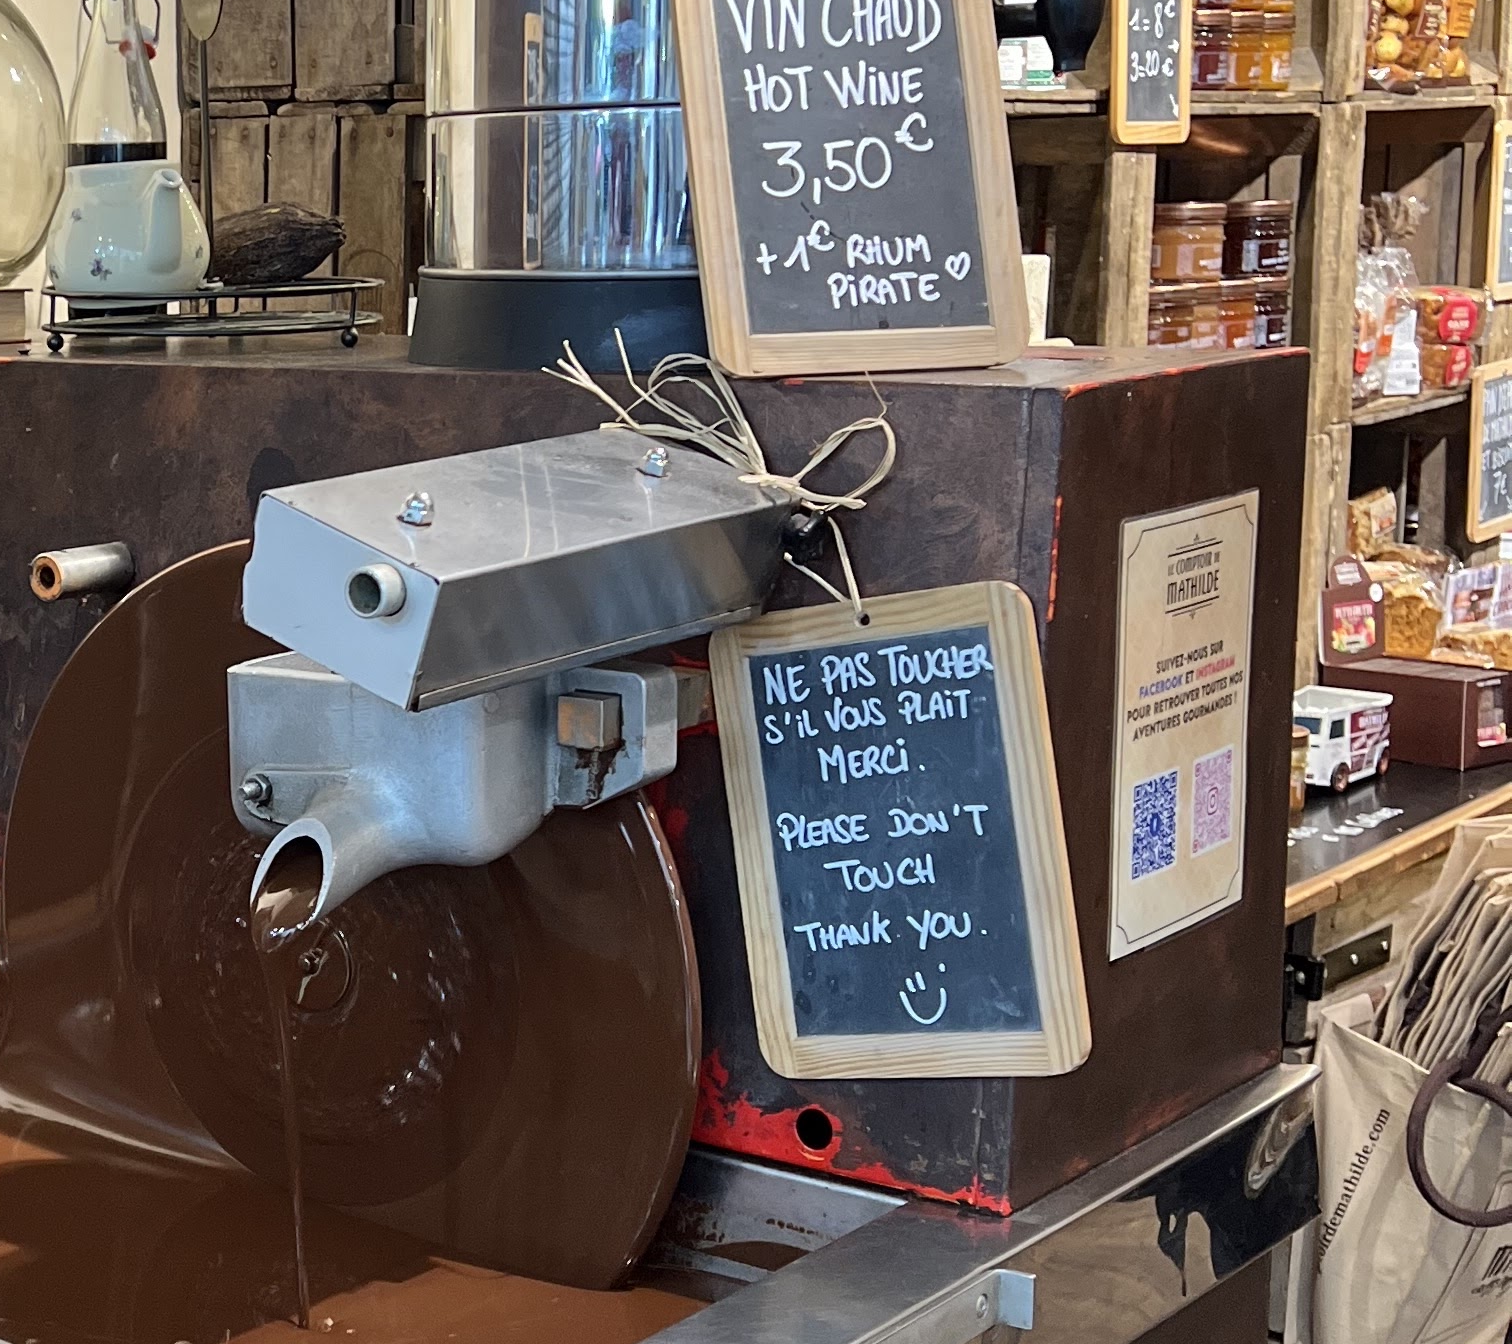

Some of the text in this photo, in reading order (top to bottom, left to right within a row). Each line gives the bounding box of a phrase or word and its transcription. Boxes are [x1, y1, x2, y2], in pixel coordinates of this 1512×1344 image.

[744, 63, 813, 112] HOT
[845, 233, 932, 269] RHUM
[1167, 569, 1220, 605] MATHILDE
[763, 644, 994, 707] NE PAS TOUCHER
[1156, 640, 1224, 674] SUIVEZ-NOUS SUR
[1127, 670, 1243, 723] POUR RETROUVER TOUTES NOS
[1139, 674, 1183, 701] FACEBOOK
[1185, 670, 1194, 685] ET
[827, 696, 887, 733] VOUS
[1132, 714, 1181, 741] AVENTURES
[1182, 694, 1233, 723] GOURMANDES
[776, 804, 989, 852] PLEASE DON'T
[823, 853, 936, 893] TOUCH
[793, 911, 891, 952] THANK
